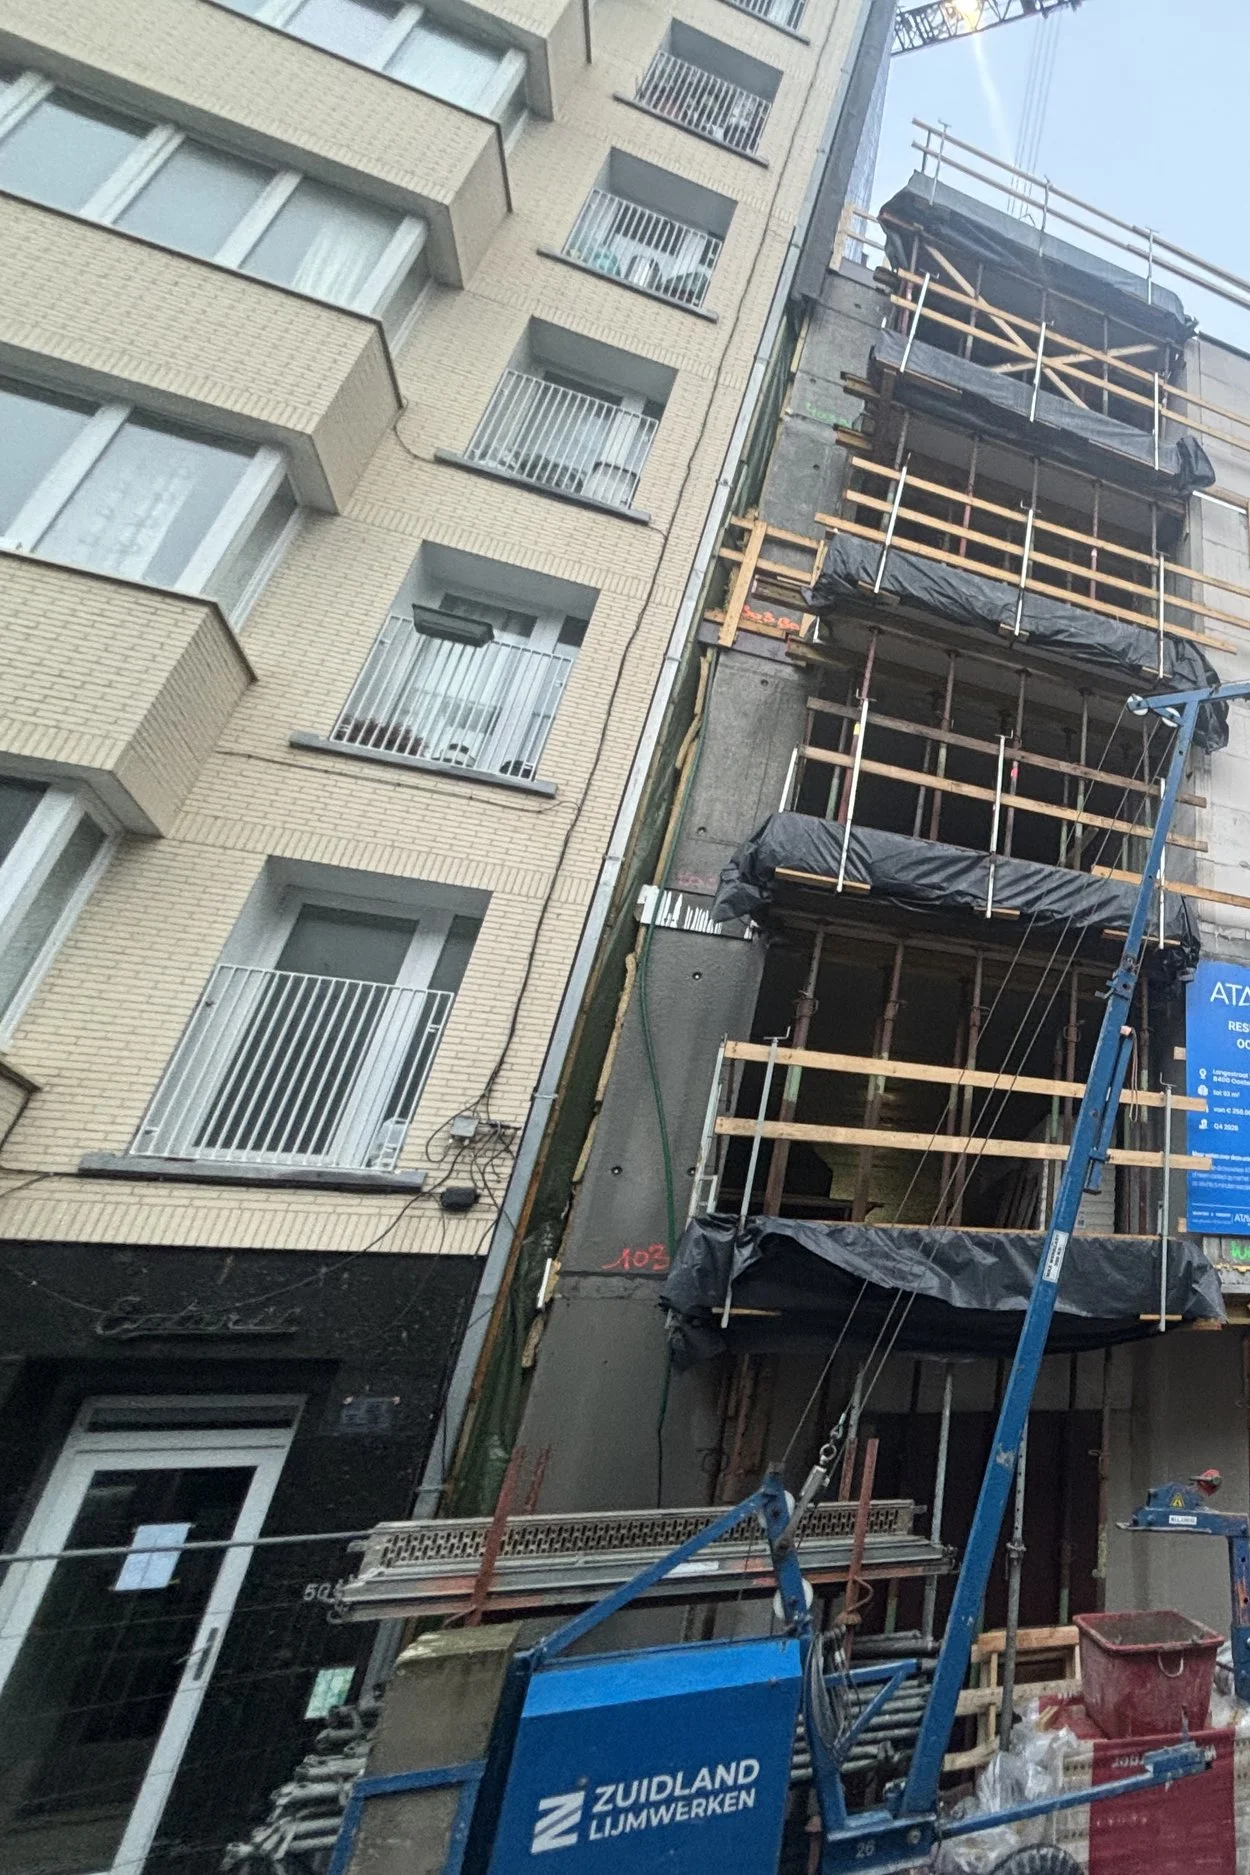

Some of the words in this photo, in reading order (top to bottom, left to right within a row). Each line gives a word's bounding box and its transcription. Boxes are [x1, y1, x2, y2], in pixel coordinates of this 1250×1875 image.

[601, 1242, 670, 1272] 103
[592, 1758, 760, 1814] ZUIDLAND
[589, 1788, 756, 1841] LIJMWERKEN
